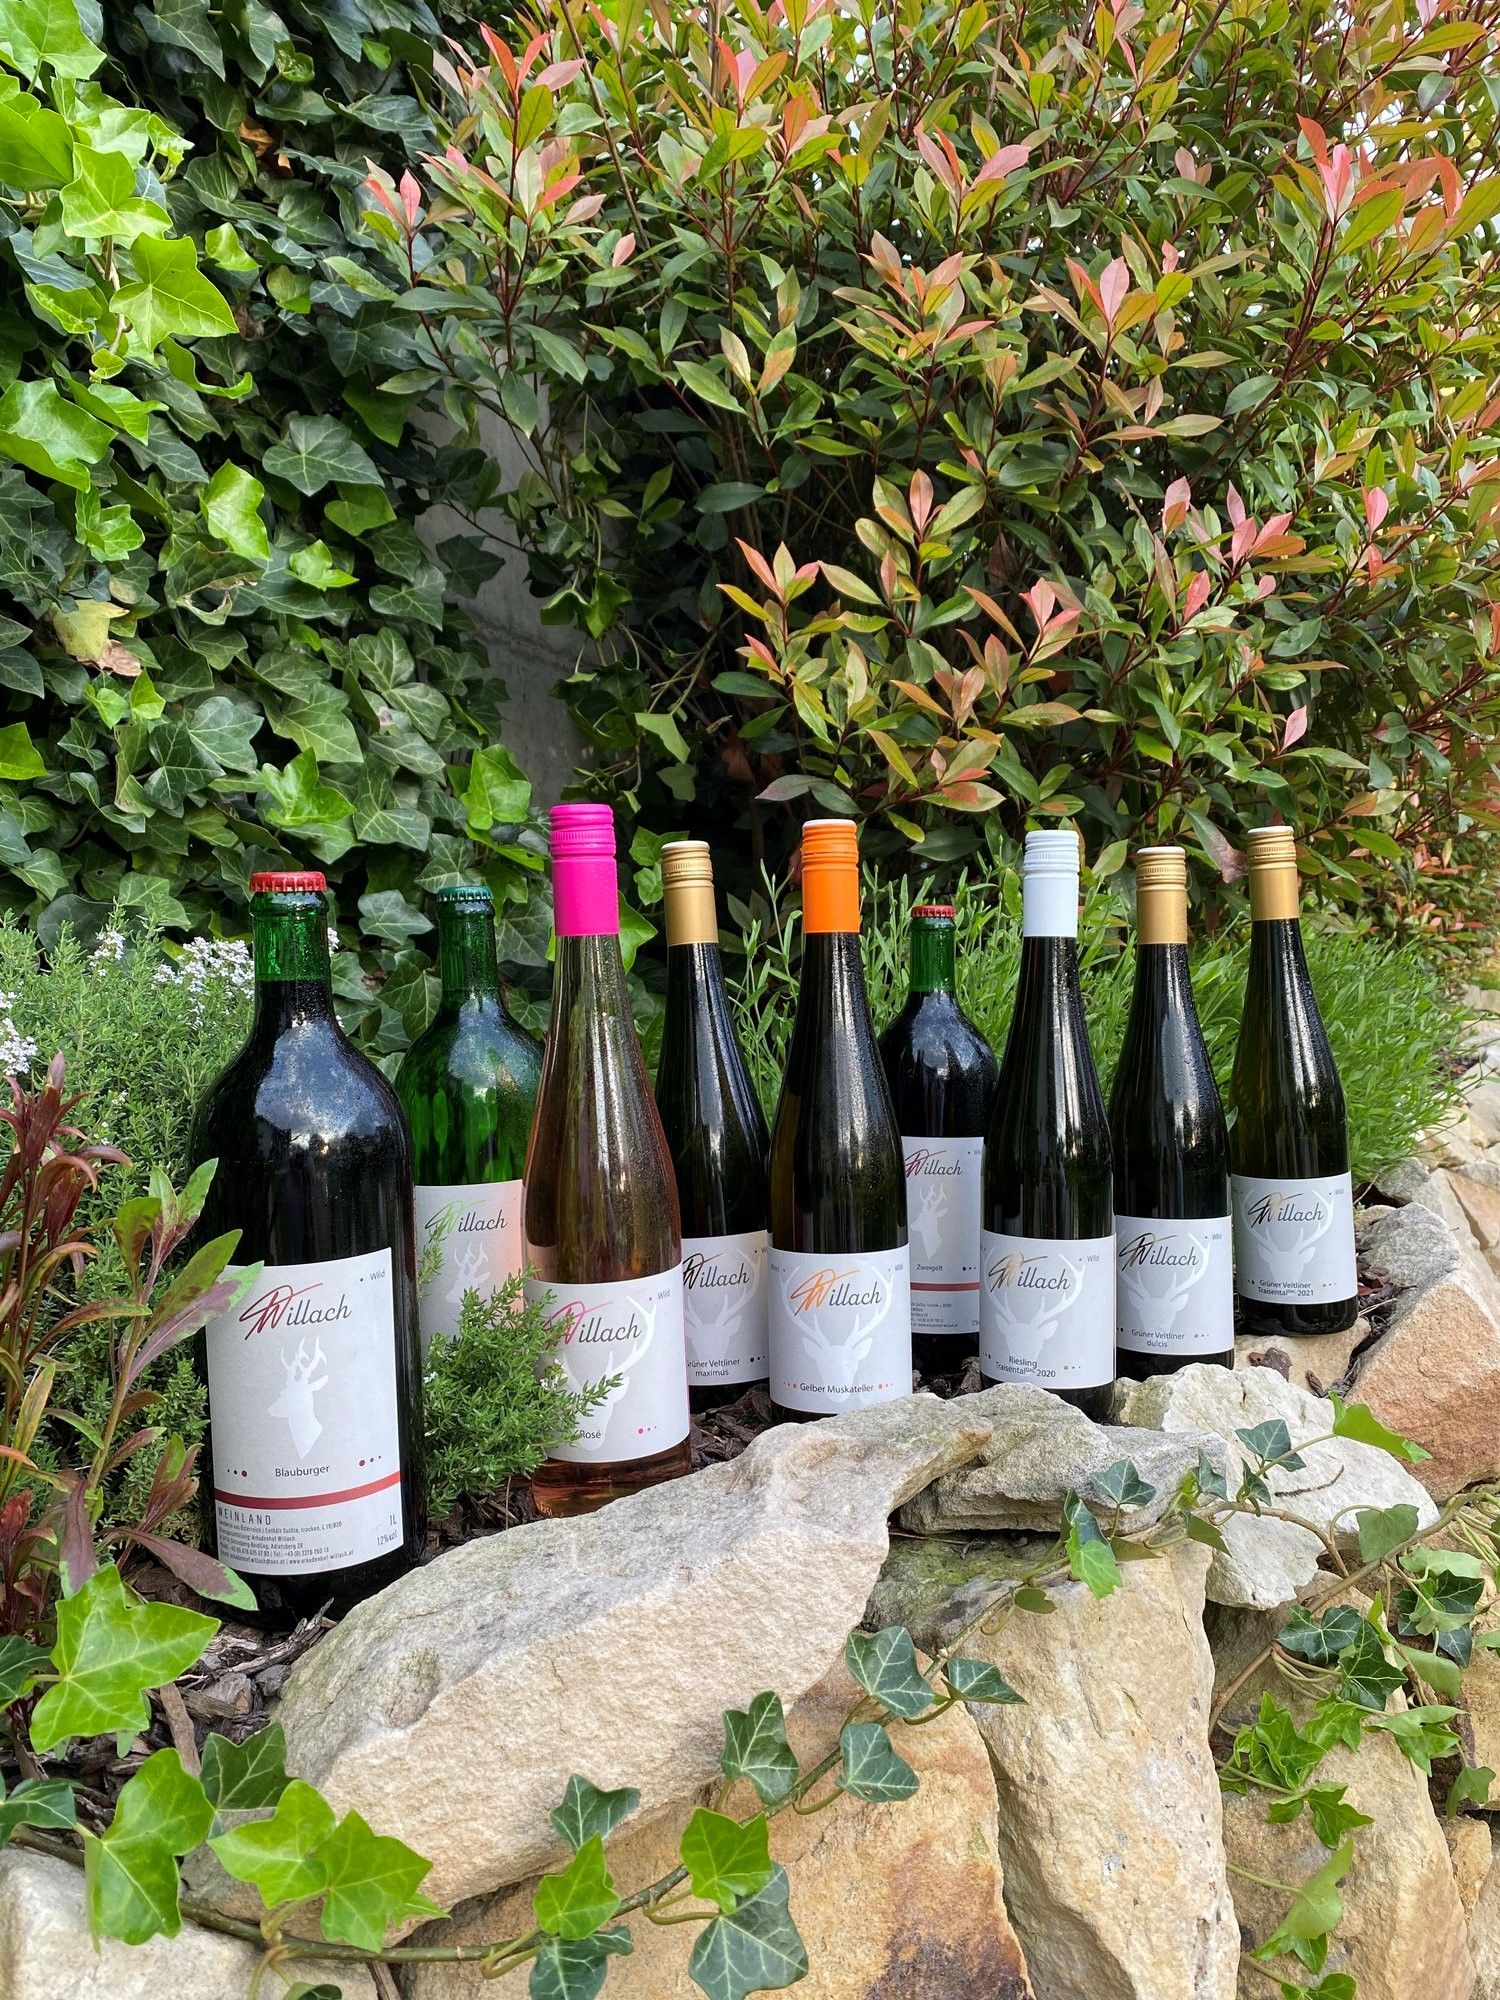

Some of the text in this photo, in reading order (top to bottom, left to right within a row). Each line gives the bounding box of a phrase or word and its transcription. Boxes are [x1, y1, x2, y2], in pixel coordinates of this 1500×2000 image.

[1248, 1192, 1324, 1228] Willach
[425, 1199, 508, 1243] Willach
[1119, 1232, 1199, 1271] Willach
[1087, 1254, 1100, 1262] Wild
[916, 1263, 943, 1272] Zweigelt
[988, 1249, 1071, 1292] Willach
[370, 1270, 386, 1281] Wild
[657, 1289, 671, 1300] Wild
[790, 1268, 883, 1316] Willach
[238, 1282, 353, 1341] Willach
[1131, 1329, 1185, 1340] Grüner Veltliner
[1146, 1339, 1168, 1348] dulcis
[687, 1358, 741, 1368] rüner Veltliner
[1008, 1356, 1038, 1370] Riesling
[695, 1369, 730, 1377] maximus
[1036, 1369, 1056, 1378] 2020
[800, 1382, 874, 1394] Gelber Muskateller
[579, 1430, 602, 1438] Rosé
[274, 1465, 330, 1478] Blauburger
[218, 1506, 271, 1526] WEINLAND
[389, 1513, 398, 1526] 1L
